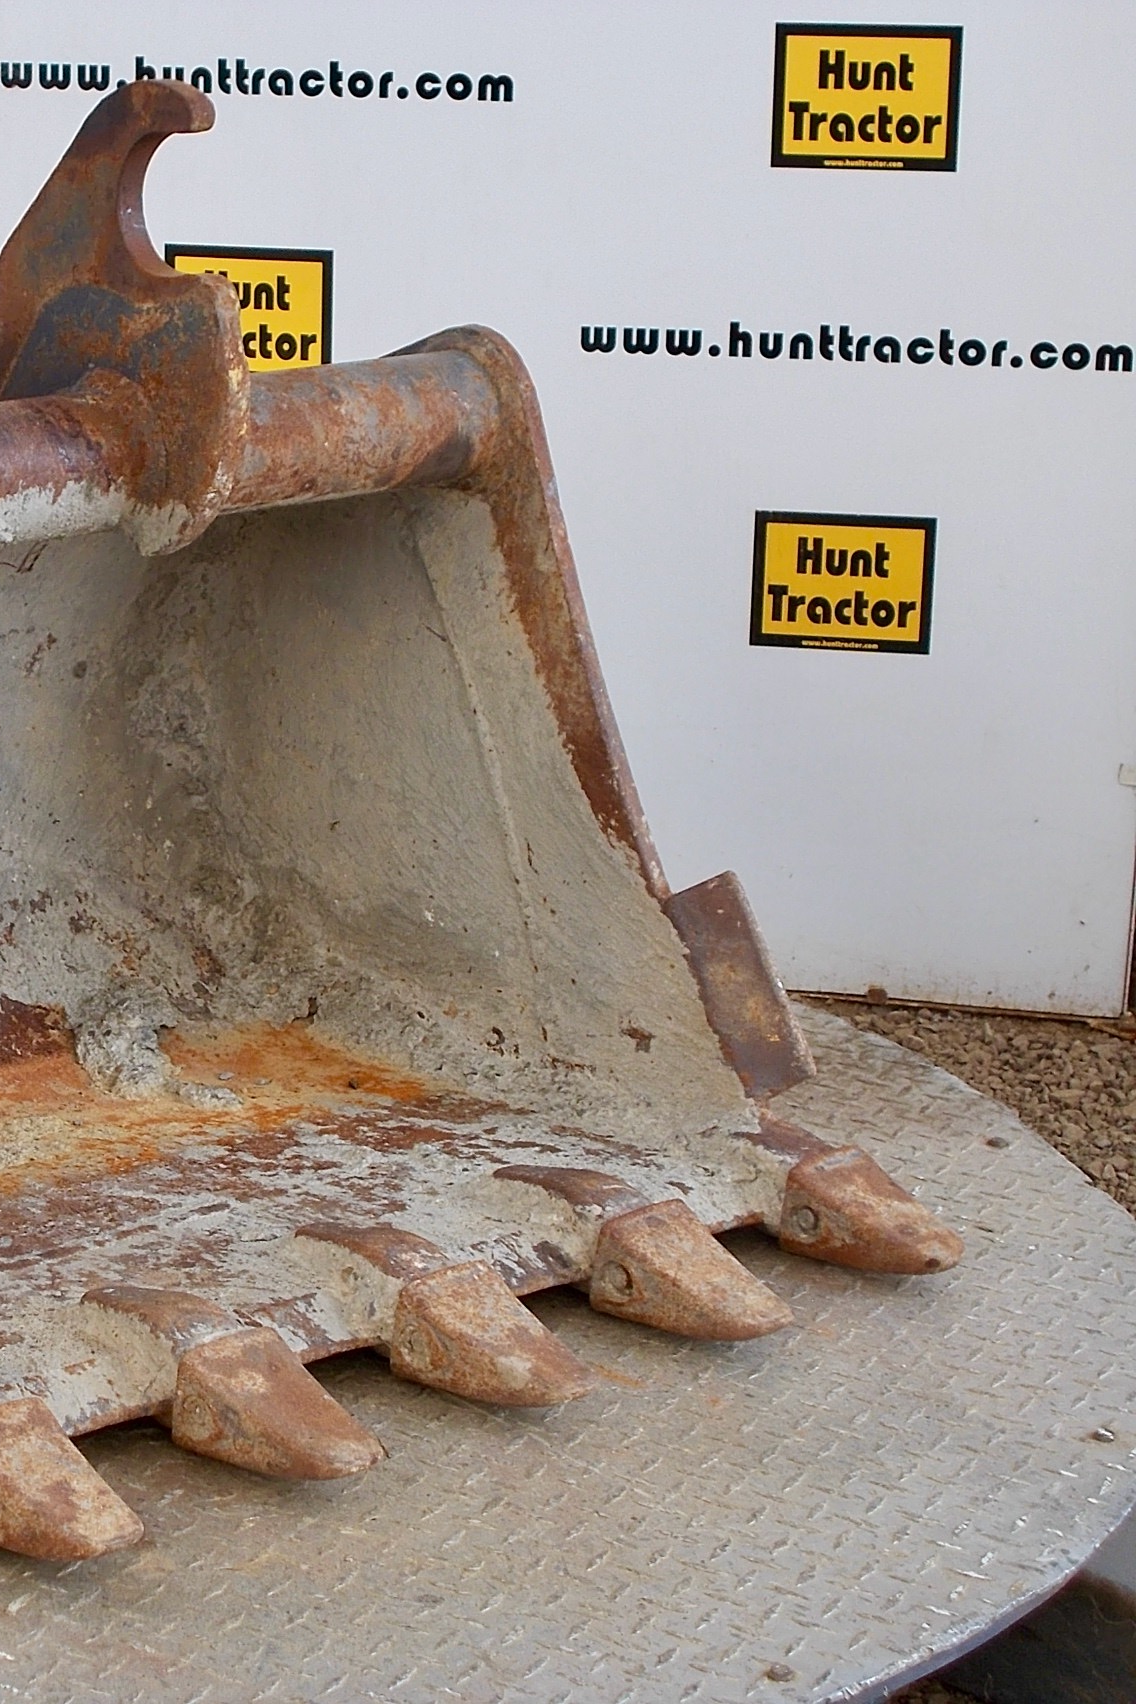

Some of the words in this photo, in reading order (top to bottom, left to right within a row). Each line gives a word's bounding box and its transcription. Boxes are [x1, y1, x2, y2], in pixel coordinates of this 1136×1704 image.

[817, 49, 915, 91] Hunt
[788, 101, 943, 144] Tractor
[204, 269, 291, 312] unt
[580, 320, 1134, 373] www.hunttractor.com
[796, 535, 890, 579] Hunt
[767, 583, 917, 628] Tractor
